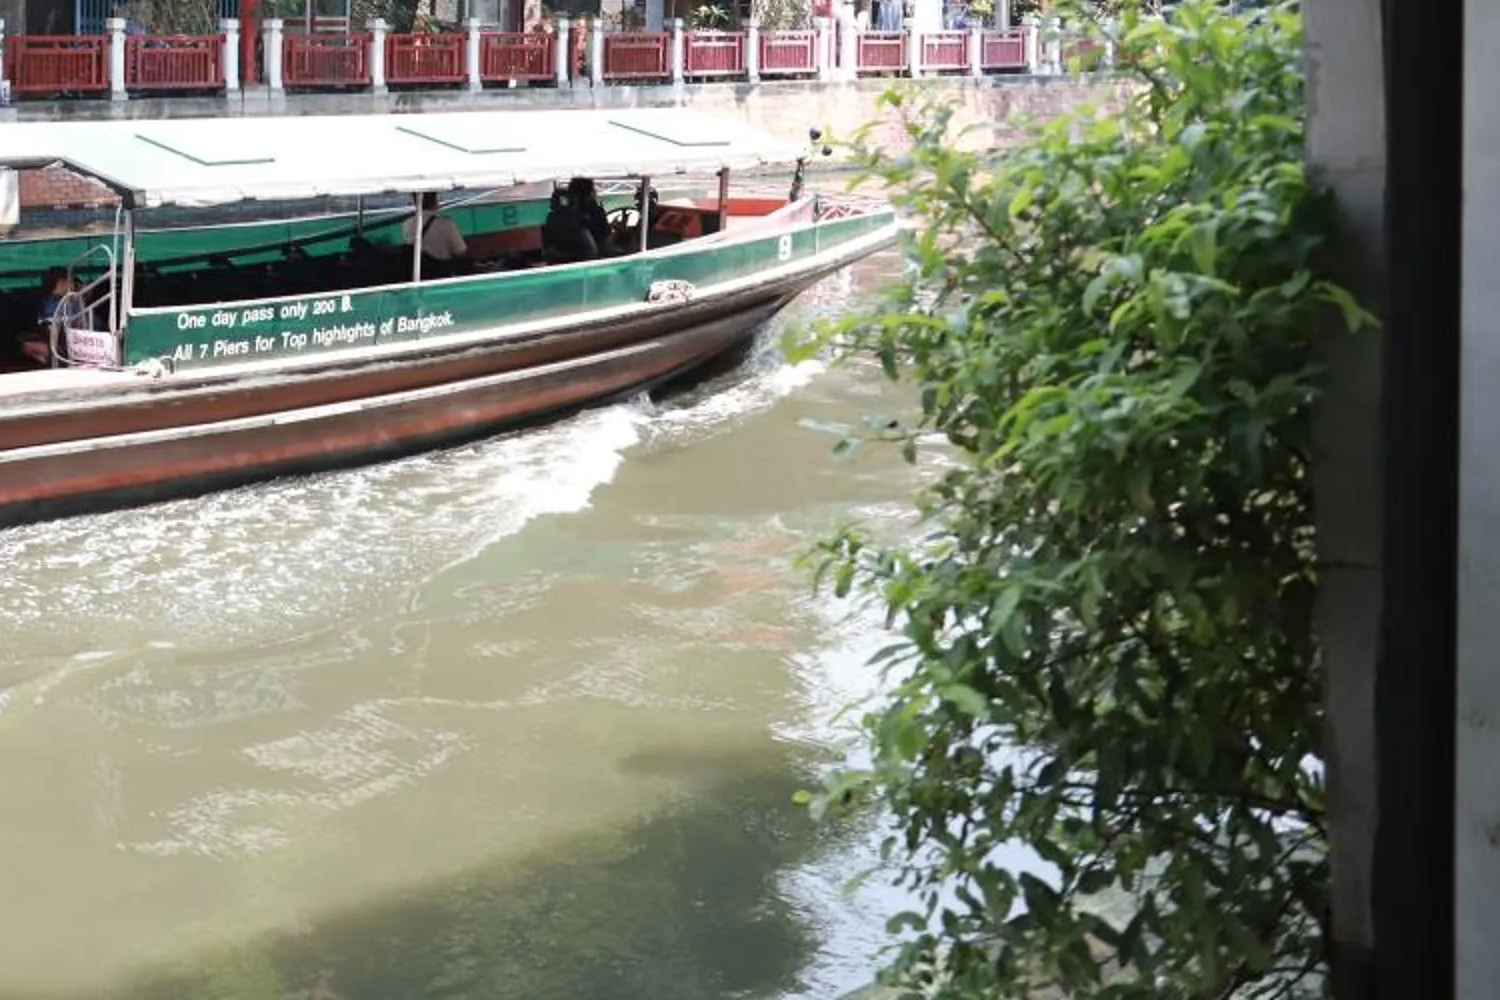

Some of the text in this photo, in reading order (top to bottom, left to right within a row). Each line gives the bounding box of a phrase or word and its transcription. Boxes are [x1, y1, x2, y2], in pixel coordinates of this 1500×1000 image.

[177, 312, 207, 330] One
[211, 310, 238, 328] day
[241, 307, 275, 326] pass
[280, 302, 308, 320] only
[311, 300, 337, 315] 200
[173, 310, 455, 361] All 7 Piers for Top highlights of Bangkok.
